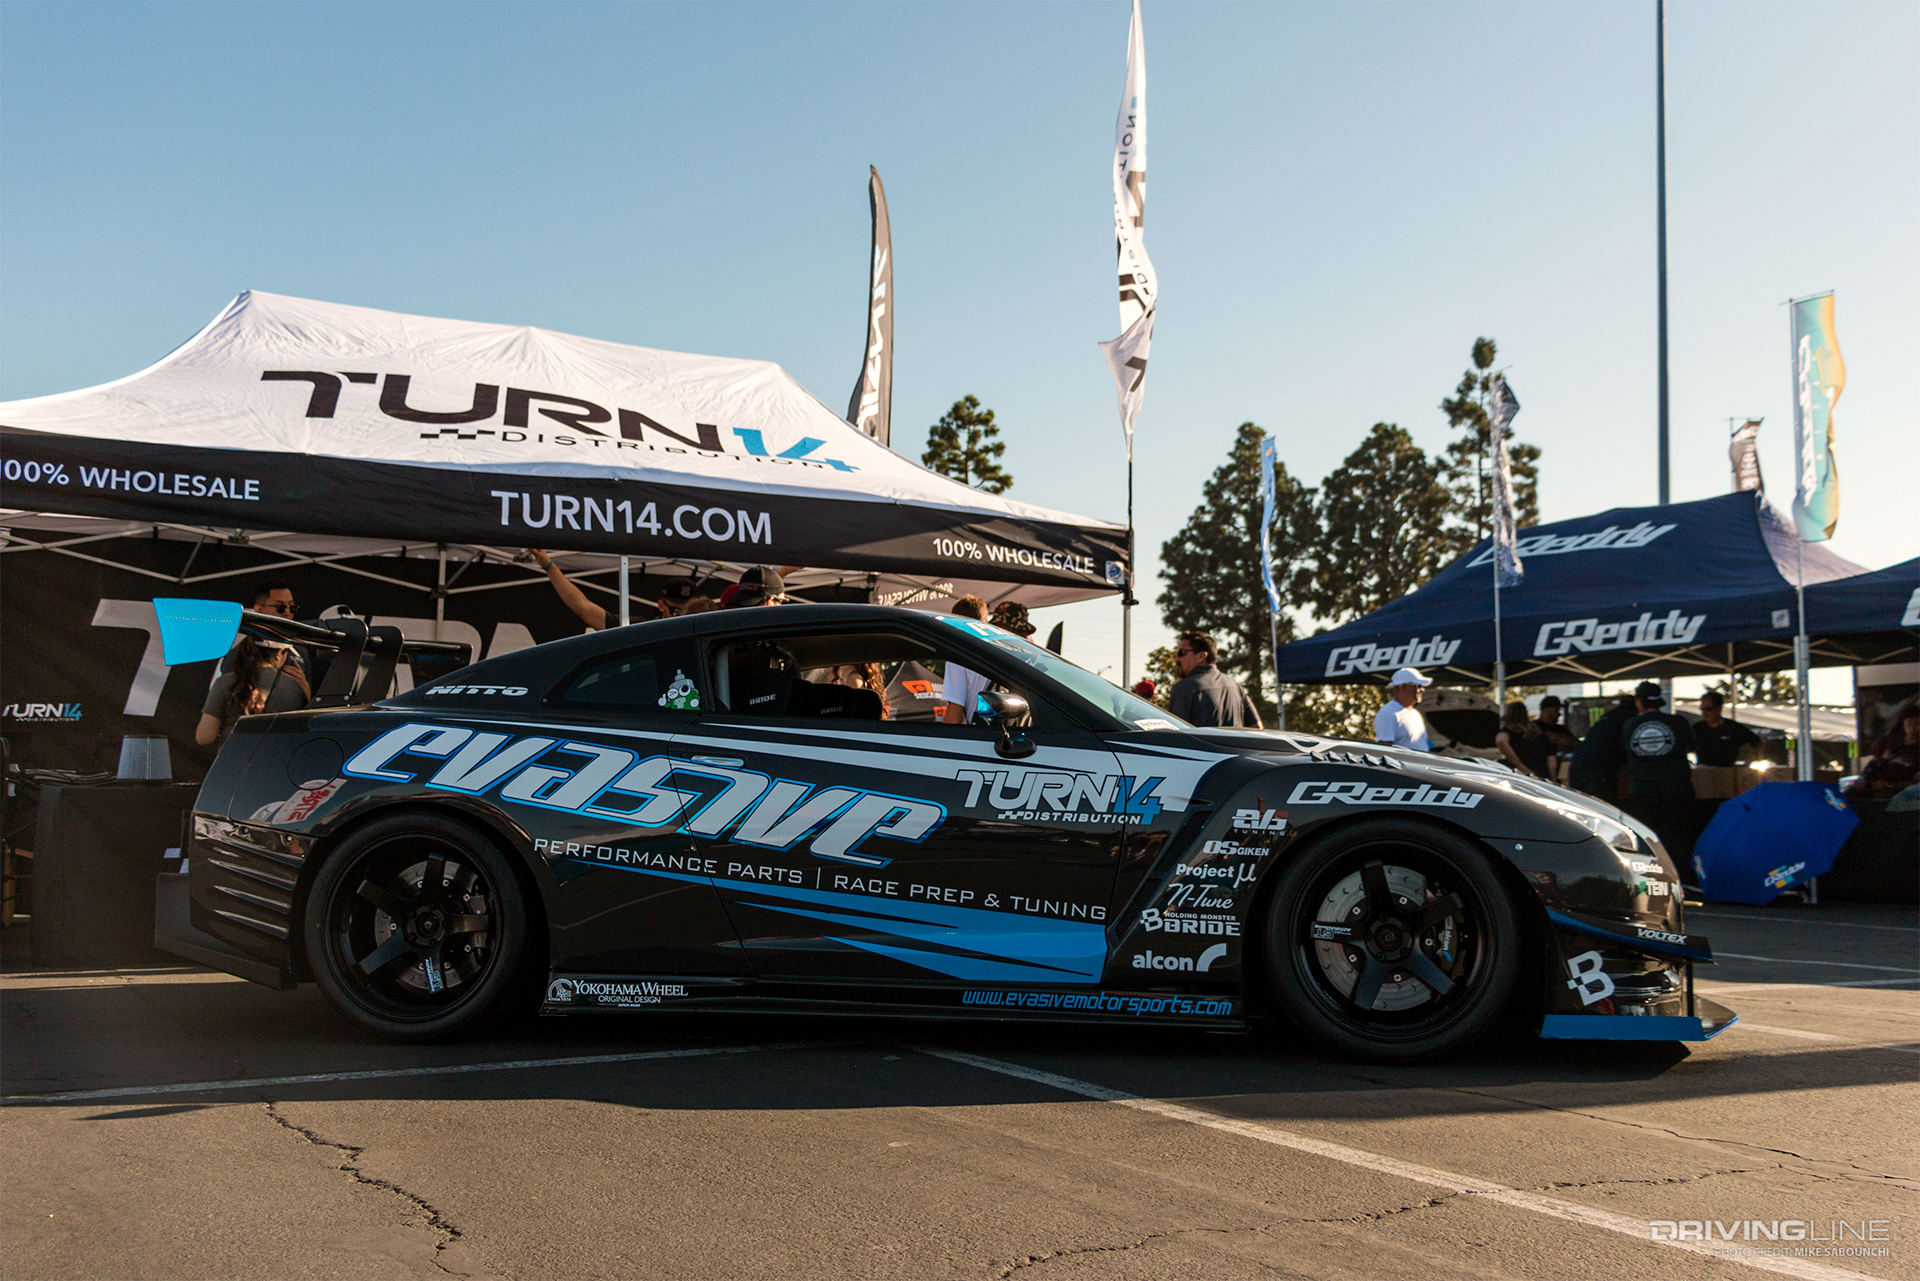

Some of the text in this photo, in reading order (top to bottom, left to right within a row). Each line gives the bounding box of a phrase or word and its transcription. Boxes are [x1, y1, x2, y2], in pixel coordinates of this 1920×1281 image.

[260, 370, 861, 473] TURN14
[502, 431, 824, 469] DISTRIBUTION
[0, 459, 260, 500] 00% WHOLESALE
[490, 490, 773, 545] TURN14.COM
[932, 538, 983, 560] 100%
[985, 544, 1094, 574] WHOLESALE
[1533, 609, 1707, 657] GReddy
[1324, 635, 1463, 677] GReddy
[425, 685, 529, 697] NITTO
[750, 694, 777, 705] BRIDE
[342, 721, 948, 869] evasive
[955, 768, 1167, 826] TURN14
[1286, 781, 1485, 809] GReddy
[1023, 811, 1141, 825] DISTRIBUTION
[1237, 847, 1269, 856] GIKEN
[534, 838, 1107, 921] PERFORMANCE PARTS RACE PREP & TUNING
[1163, 919, 1241, 936] BRIDE
[1637, 928, 1688, 945] VOLTEX
[1132, 950, 1193, 971] alcon
[572, 980, 689, 997] YOKOHAMA WHEEL
[598, 995, 661, 1004] ORIGINAL DESIGN
[962, 989, 1232, 1017] www.evasivemotorsports.com
